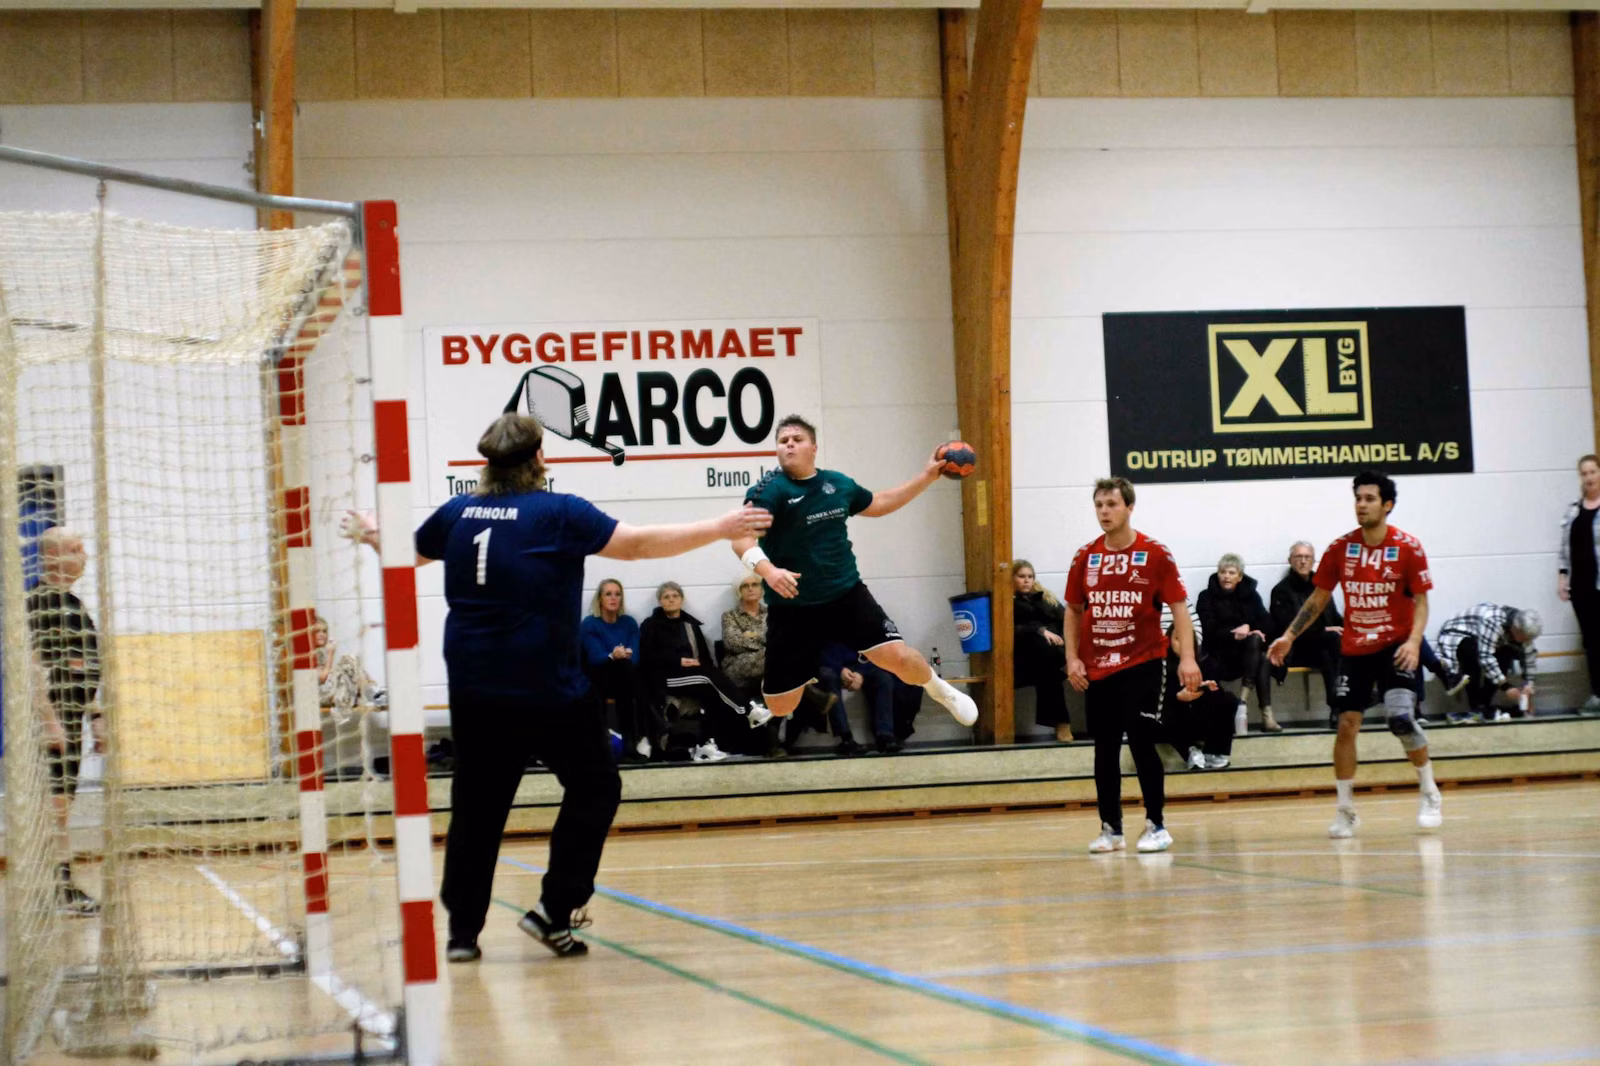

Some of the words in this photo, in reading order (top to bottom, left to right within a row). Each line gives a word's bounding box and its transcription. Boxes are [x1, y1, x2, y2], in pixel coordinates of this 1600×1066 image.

[441, 326, 803, 366] BYGGEFIRMAET
[1337, 337, 1357, 386] BYG
[1222, 337, 1359, 418] XL
[1126, 448, 1218, 470] OUTRUP
[1222, 442, 1412, 467] TØMMERHANDEL
[1416, 441, 1460, 462] A/S
[706, 467, 750, 488] Bruno
[472, 527, 492, 586] 1
[1102, 553, 1129, 575] 23
[1361, 547, 1383, 570] 14
[1088, 591, 1143, 605] SKJERN
[1345, 581, 1396, 595] SKJERN
[1091, 605, 1134, 618] BANK
[1349, 595, 1389, 608] BANK
